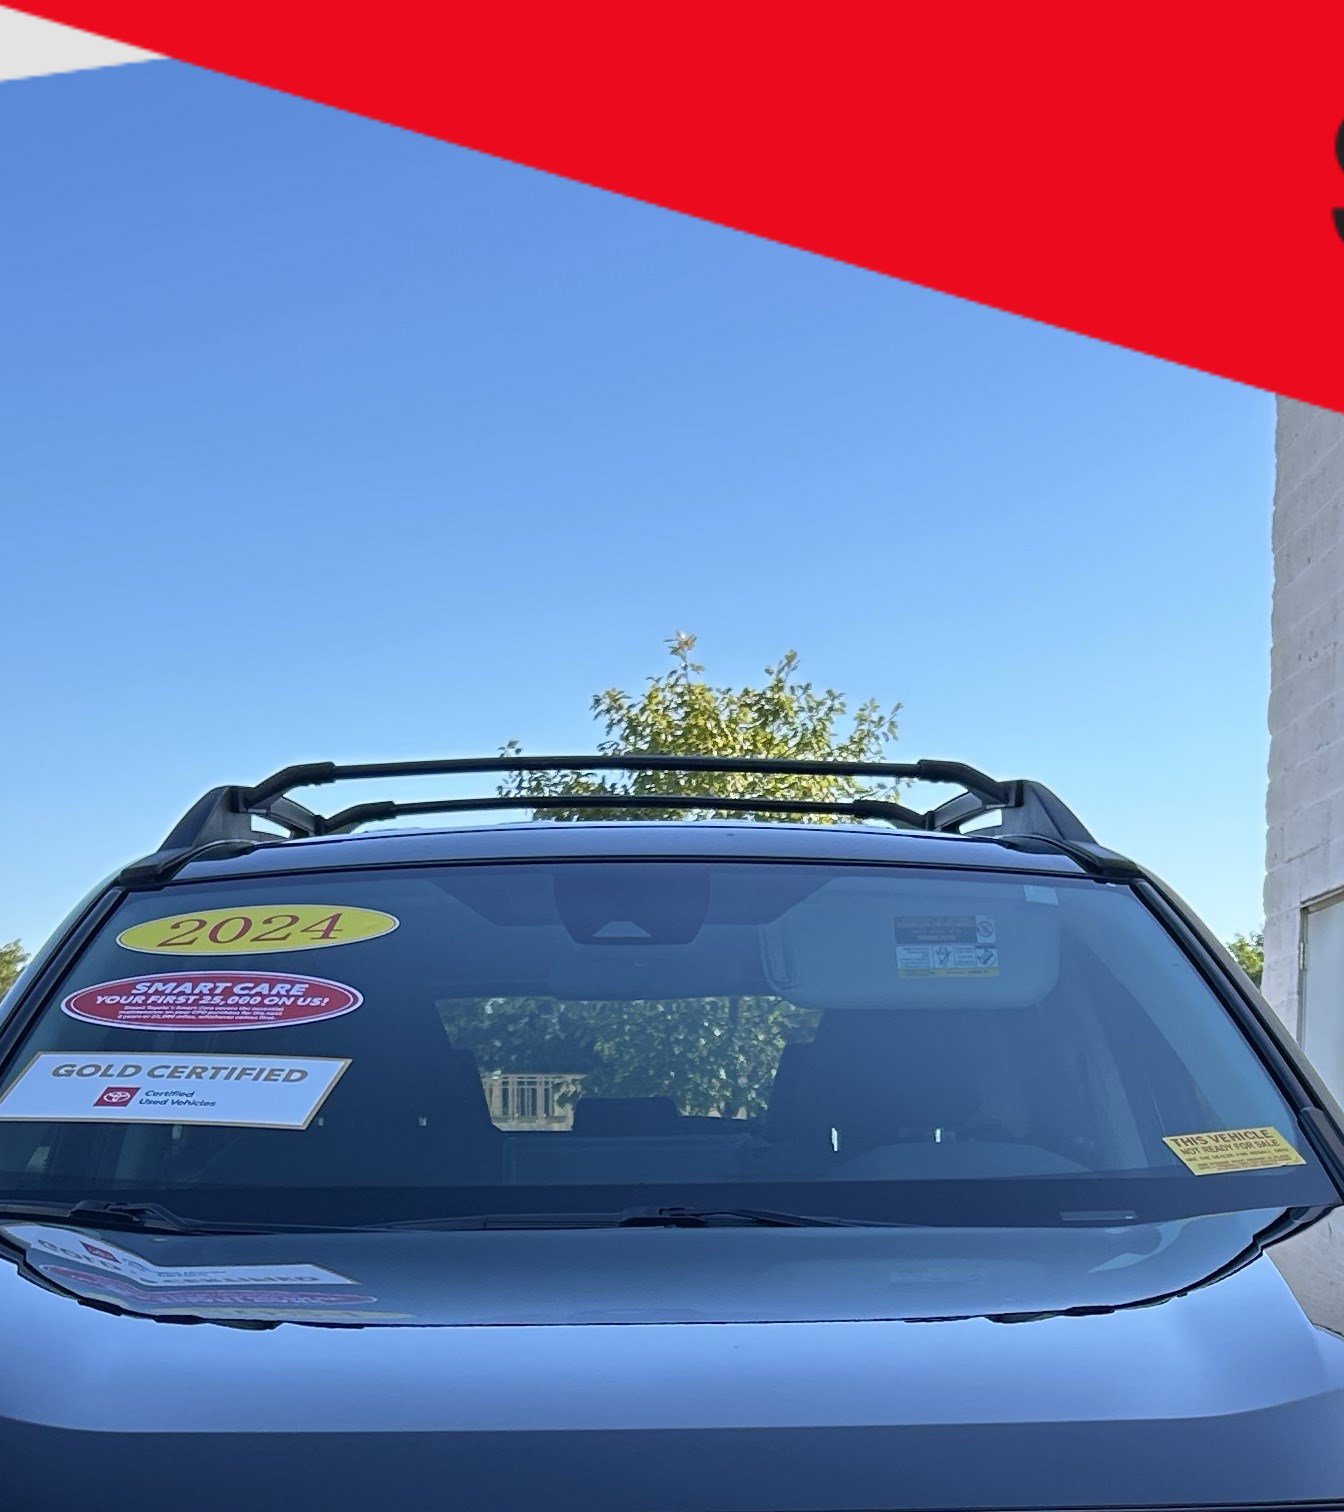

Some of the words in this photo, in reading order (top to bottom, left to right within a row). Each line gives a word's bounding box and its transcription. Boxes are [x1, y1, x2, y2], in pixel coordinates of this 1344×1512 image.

[156, 912, 344, 948] 2024
[131, 982, 230, 995] SMART
[231, 983, 310, 996] CARE
[96, 995, 145, 1005] YOUR
[146, 995, 199, 1005] FIRST
[199, 996, 262, 1006] 25,000
[264, 997, 295, 1006] ON
[297, 997, 330, 1007] US!
[52, 1063, 142, 1078] GOLD
[146, 1065, 309, 1083] CERTIFIED
[145, 1090, 195, 1098] Certified
[139, 1098, 169, 1106] Used
[171, 1098, 216, 1107] Vehicles
[1169, 1135, 1209, 1147] THIS
[1207, 1129, 1275, 1144] VEHICLE
[1180, 1146, 1202, 1155] NOT
[1202, 1143, 1233, 1154] READY
[1233, 1141, 1255, 1151] FOR
[1255, 1138, 1281, 1149] SALE
